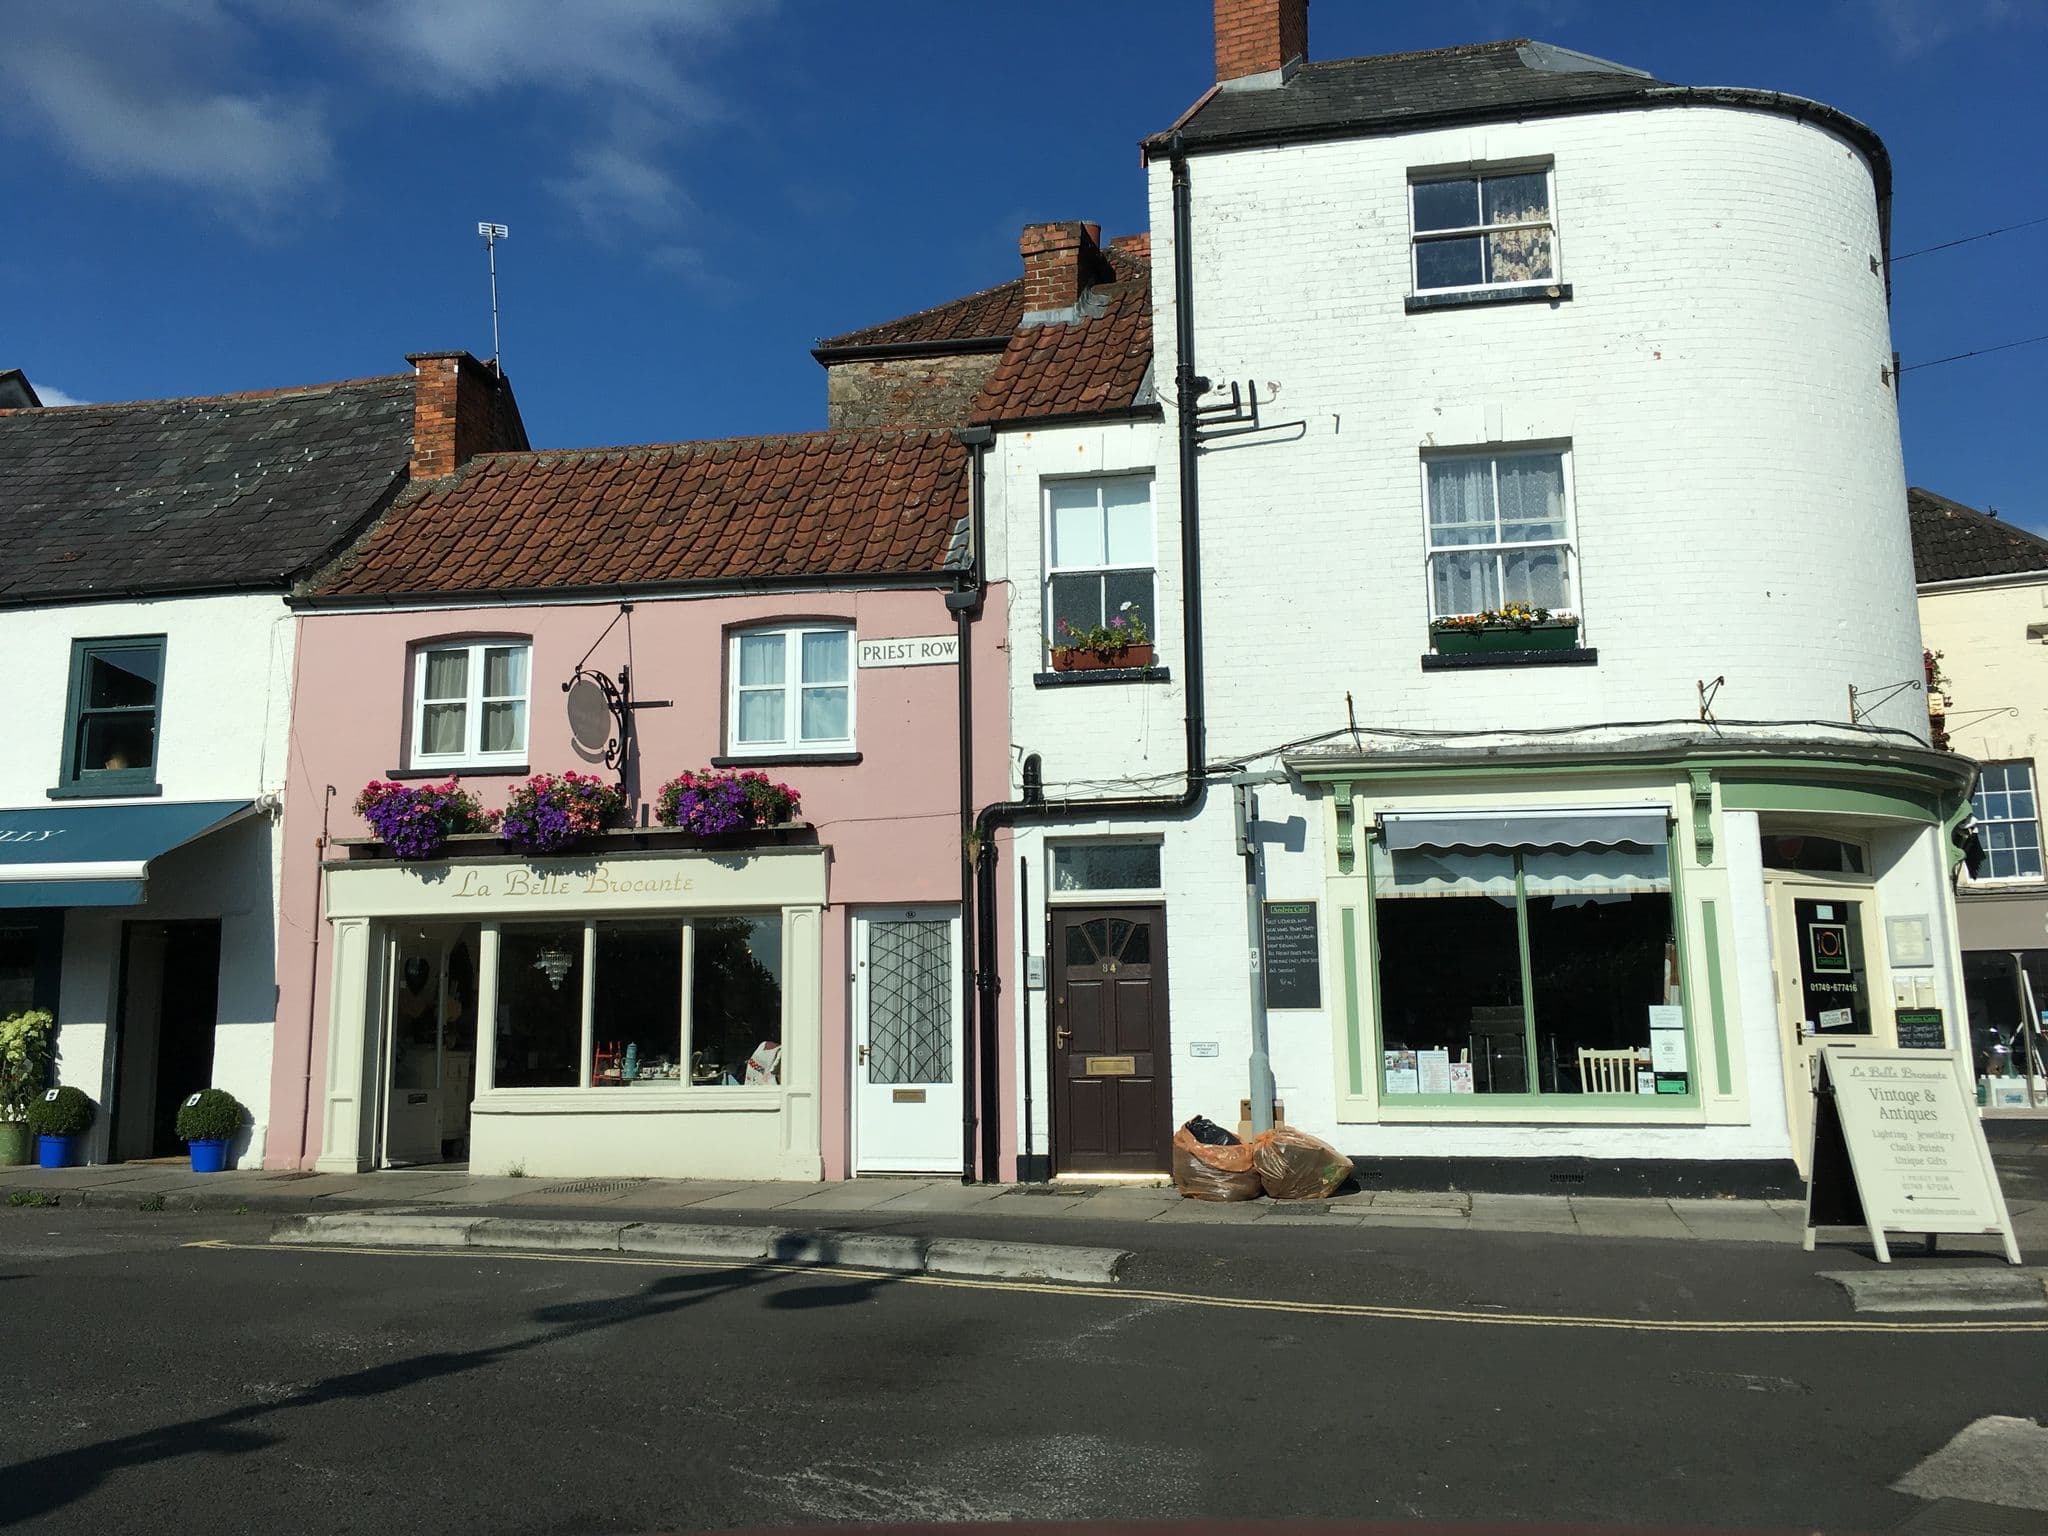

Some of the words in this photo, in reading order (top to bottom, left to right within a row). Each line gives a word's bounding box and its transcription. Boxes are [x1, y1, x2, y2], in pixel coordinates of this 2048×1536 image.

[863, 644, 916, 661] PRIEST
[921, 641, 957, 658] ROW
[0, 829, 67, 842] LLY
[452, 869, 491, 898] La
[503, 868, 570, 897] Belle
[583, 867, 696, 895] Brocante
[1849, 1066, 1866, 1078] La
[1868, 1066, 1899, 1079] Belle
[1901, 1066, 1948, 1080] Brocante
[1869, 1087, 1921, 1106] Vintage
[1924, 1088, 1937, 1103] &
[1879, 1105, 1938, 1124] Antiques
[1872, 1129, 1908, 1141] Lighting
[1916, 1130, 1955, 1142] Jewellery
[1890, 1142, 1916, 1152] Chalk
[1918, 1143, 1946, 1153] Paints
[1894, 1156, 1925, 1167] Unique
[1927, 1156, 1948, 1166] Gifts
